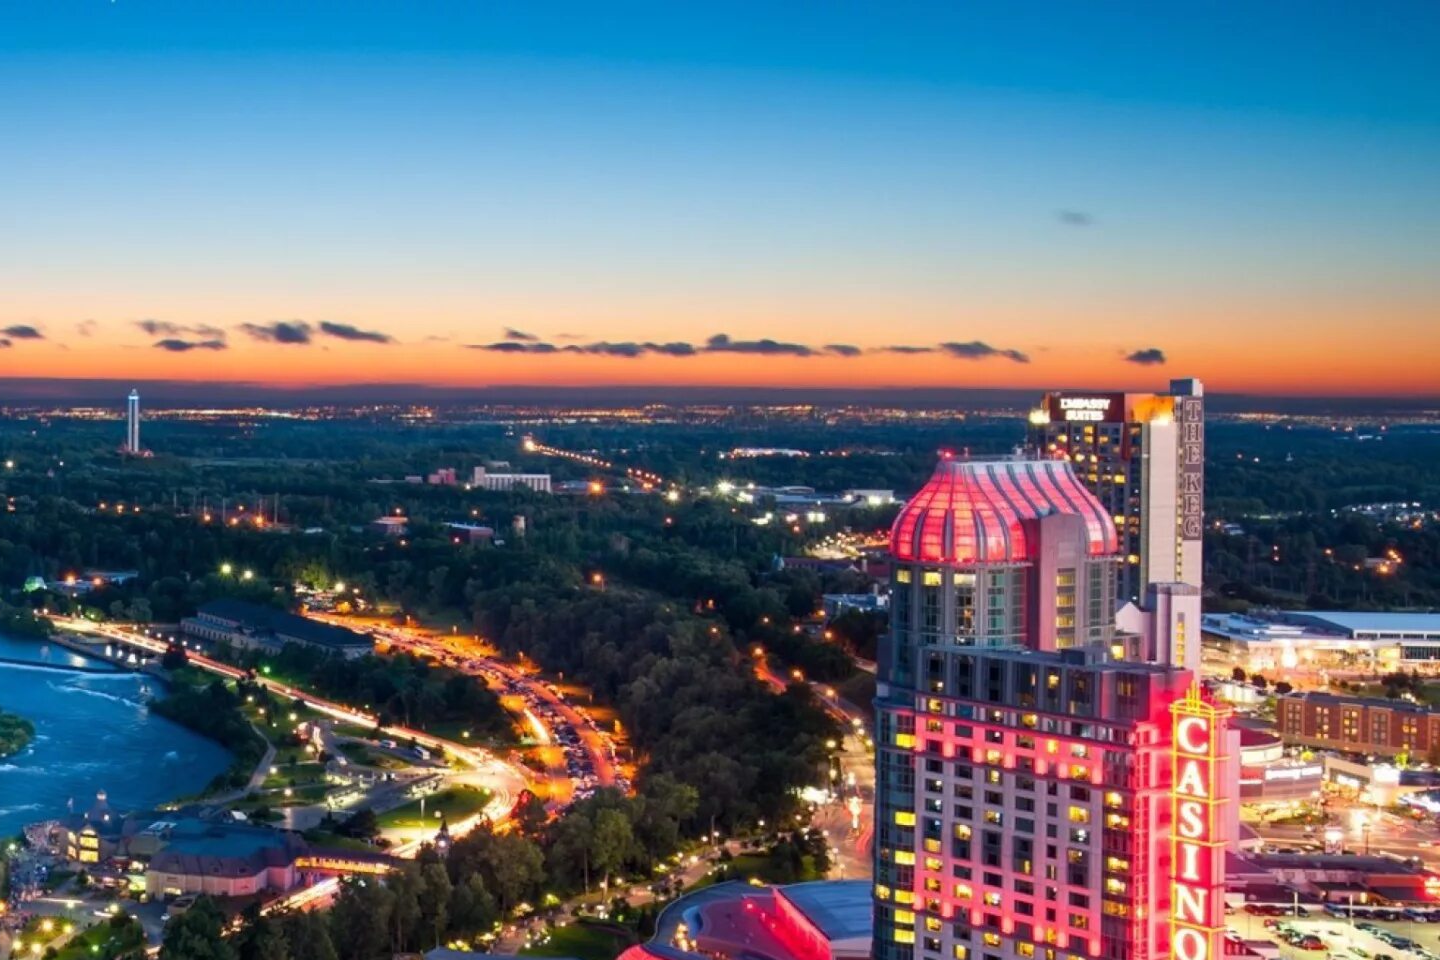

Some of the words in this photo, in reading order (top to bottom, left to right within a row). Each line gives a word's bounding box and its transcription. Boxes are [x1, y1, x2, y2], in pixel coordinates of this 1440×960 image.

[1060, 398, 1110, 410] EMBASSY
[1065, 410, 1104, 421] SUITES
[1184, 400, 1202, 465] THE
[1184, 472, 1202, 537] KEG
